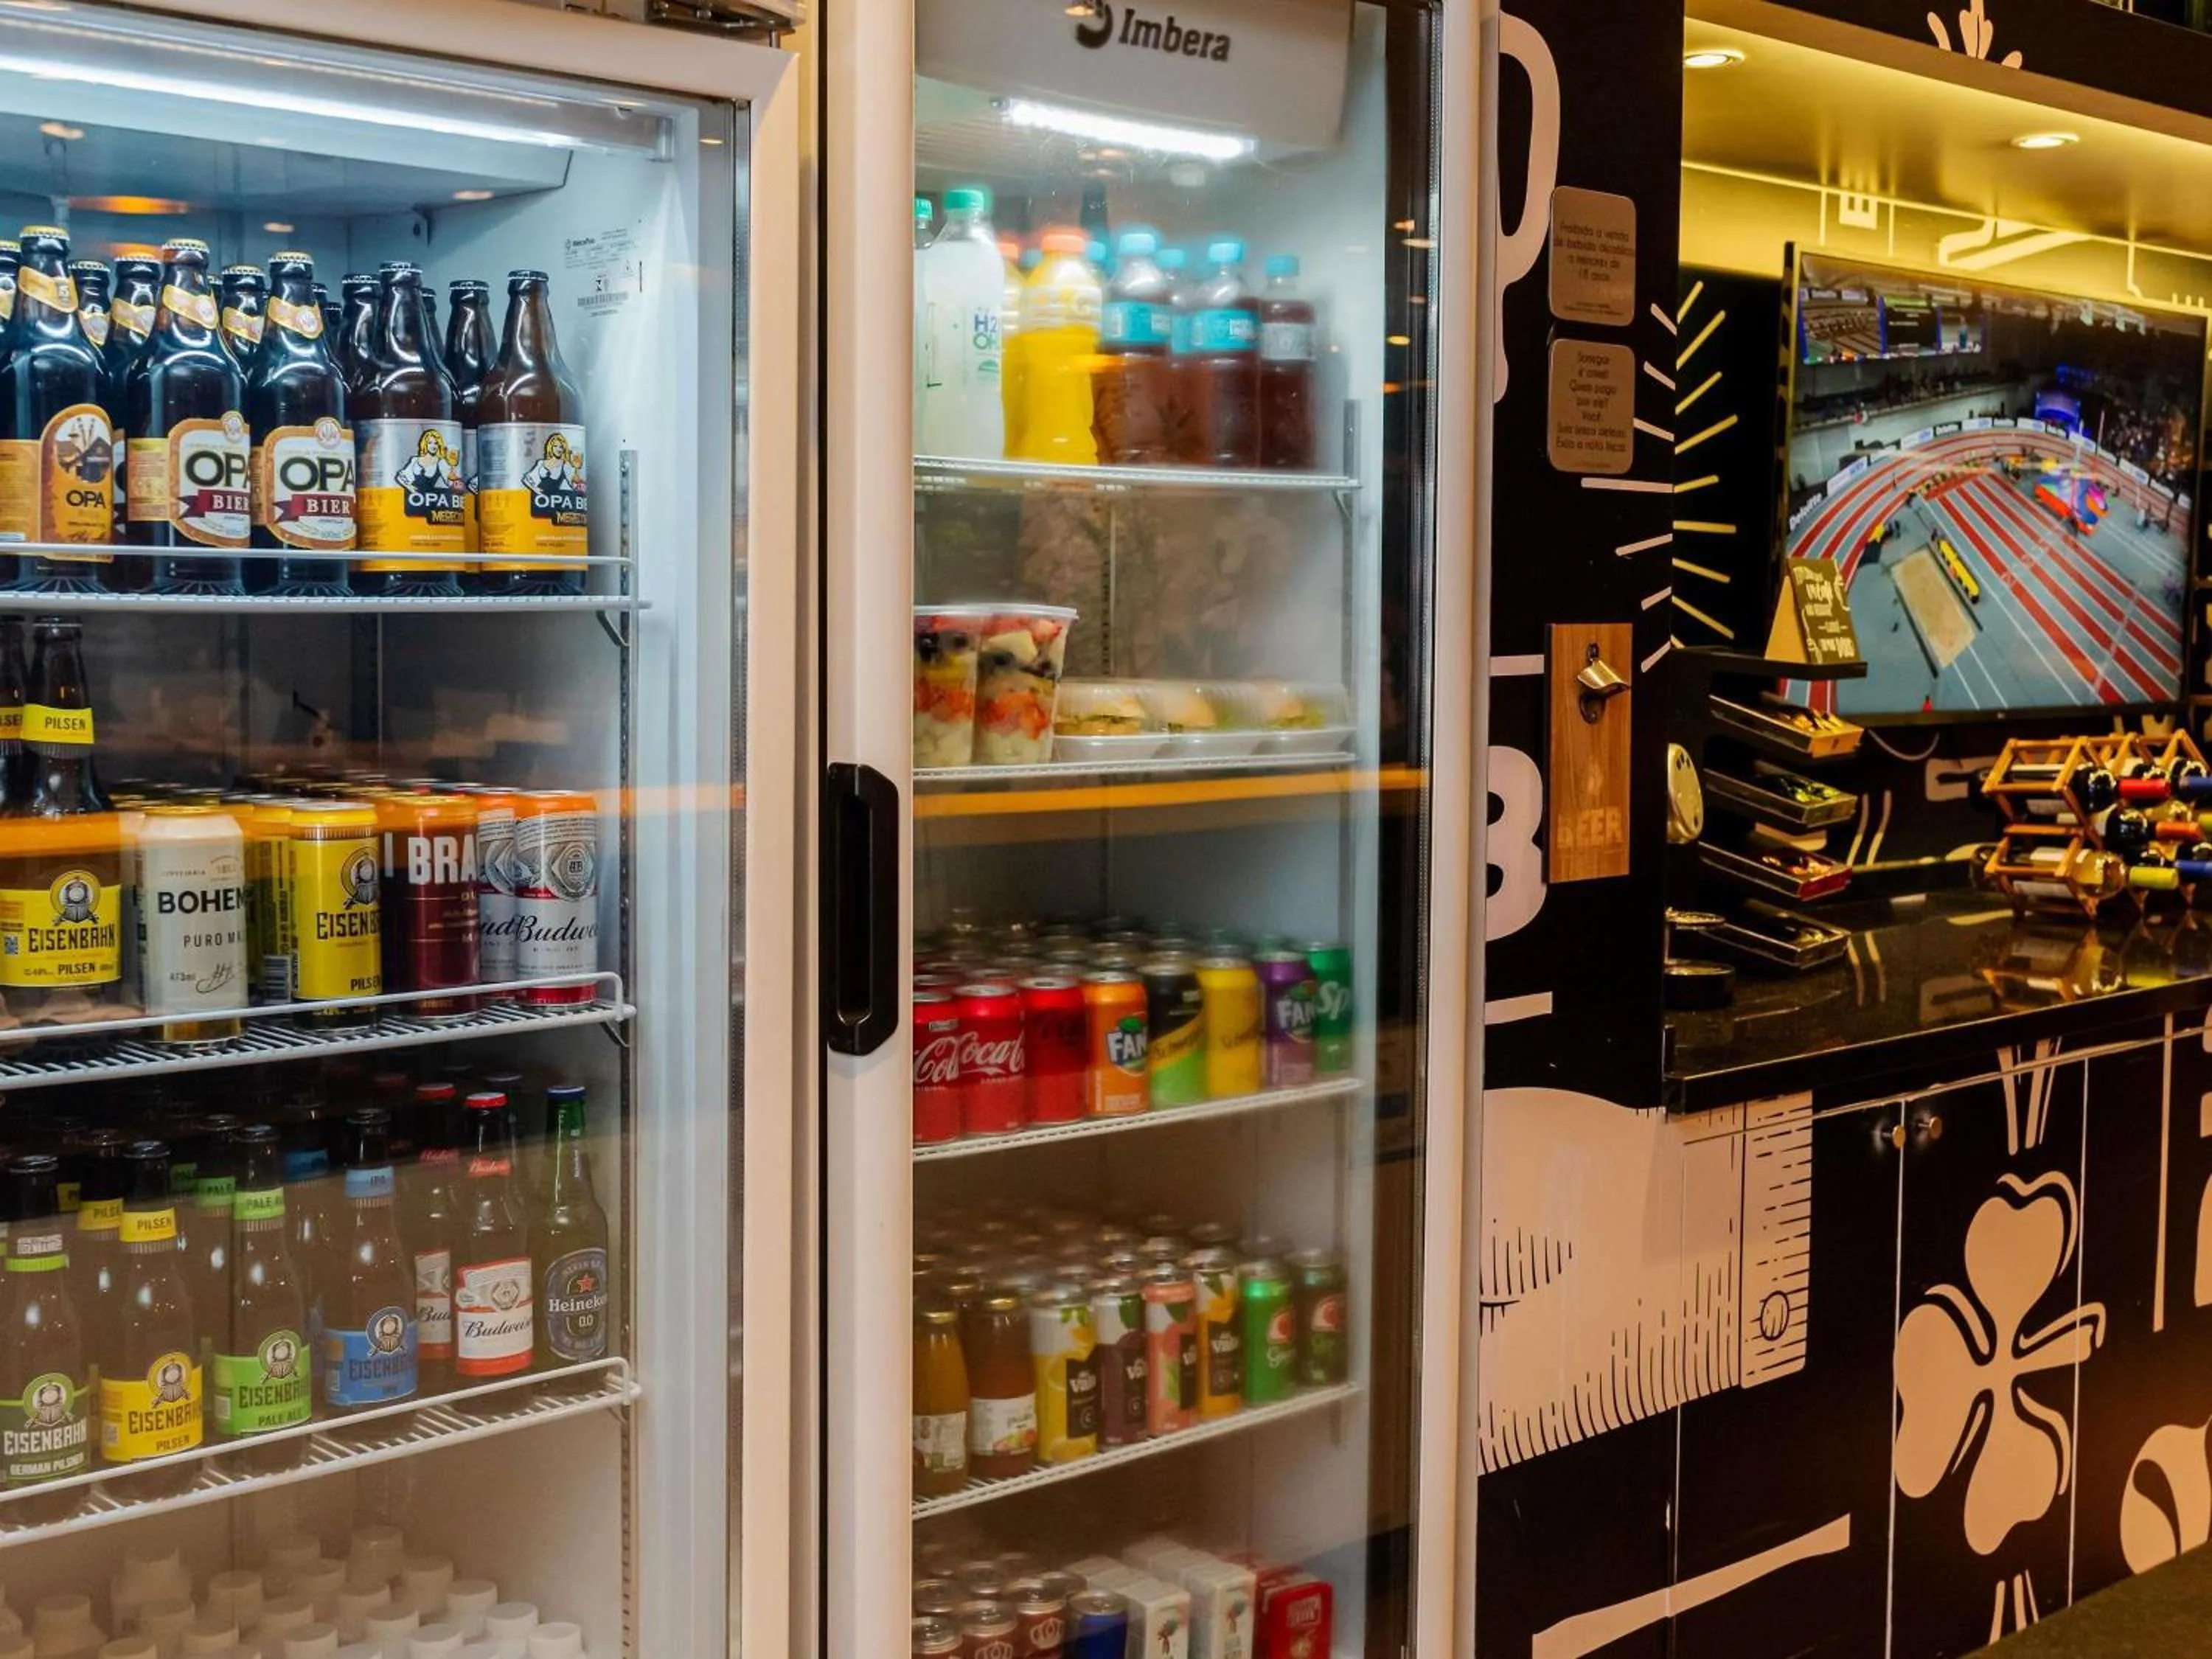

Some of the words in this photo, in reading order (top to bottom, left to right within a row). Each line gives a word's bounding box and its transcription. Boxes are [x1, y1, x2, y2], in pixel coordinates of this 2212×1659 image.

[1119, 8, 1231, 62] Imbera
[66, 489, 107, 509] OPA
[306, 498, 351, 515] BIER
[408, 493, 449, 508] OPA
[535, 494, 572, 509] OPA
[44, 716, 86, 731] PILSEN
[1557, 807, 1623, 849] BEER
[28, 922, 116, 953] EISENBAHN
[184, 933, 223, 948] PURO
[58, 962, 95, 975] PILSEN
[137, 1217, 172, 1231] PILSEN
[258, 1414, 283, 1427] PALE
[4, 1416, 87, 1455] EISENBAHN
[156, 1435, 189, 1452] PILSEN
